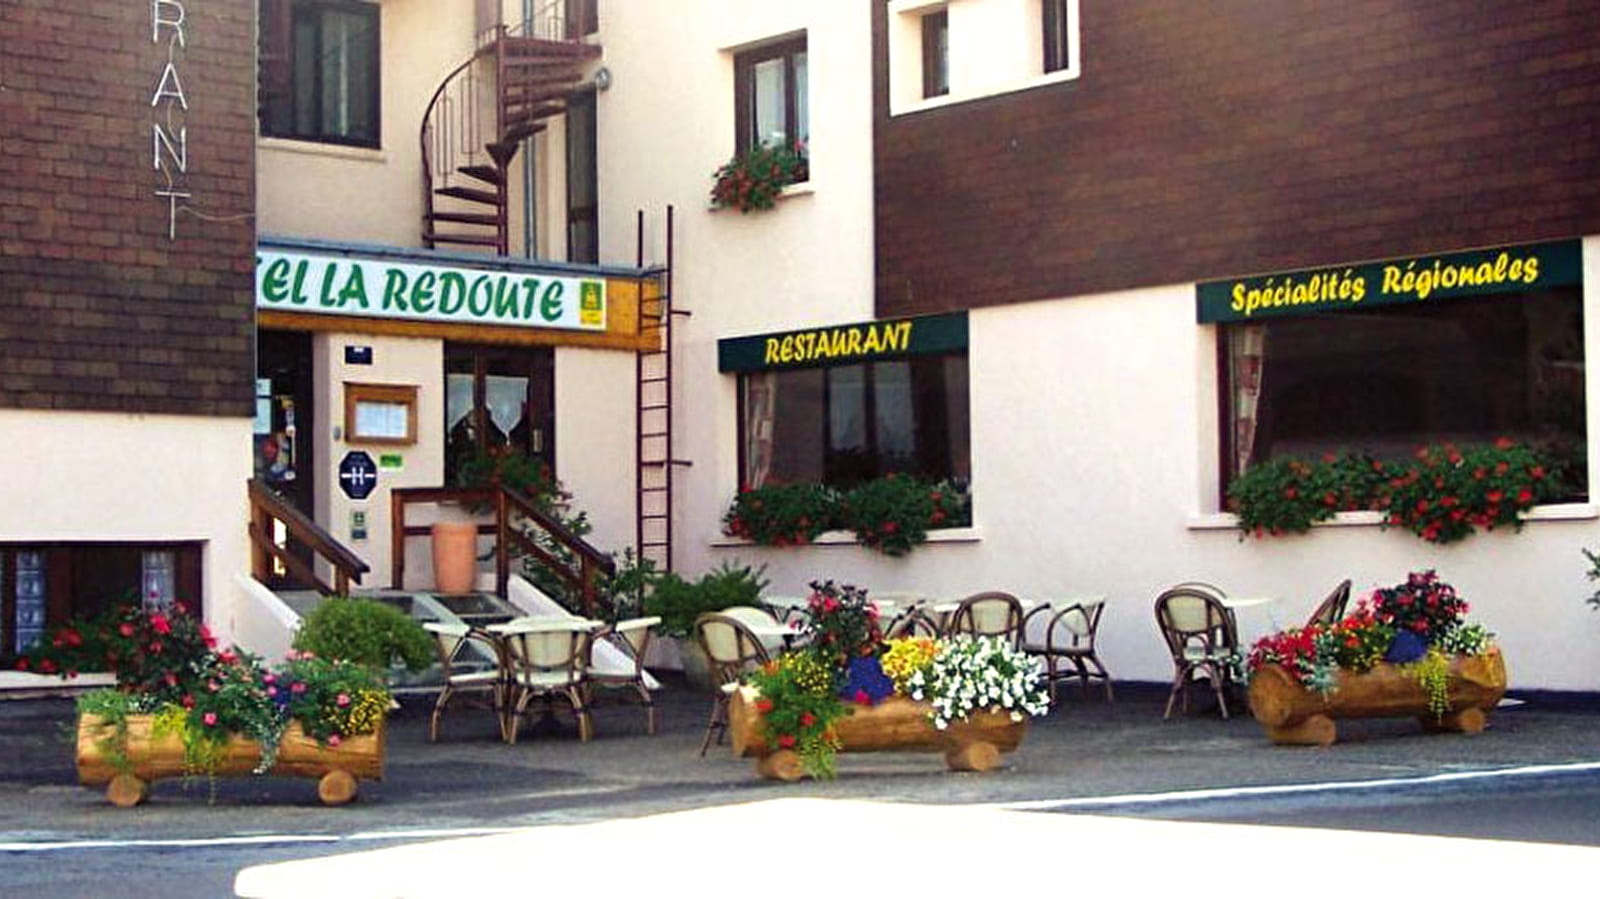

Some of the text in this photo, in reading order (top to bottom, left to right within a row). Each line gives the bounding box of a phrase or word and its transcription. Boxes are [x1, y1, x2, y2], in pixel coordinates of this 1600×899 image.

[256, 258, 565, 322] EL LA REDOUTE
[1231, 252, 1539, 315] Spécialités Régionales
[764, 321, 912, 364] RESTAURANT
